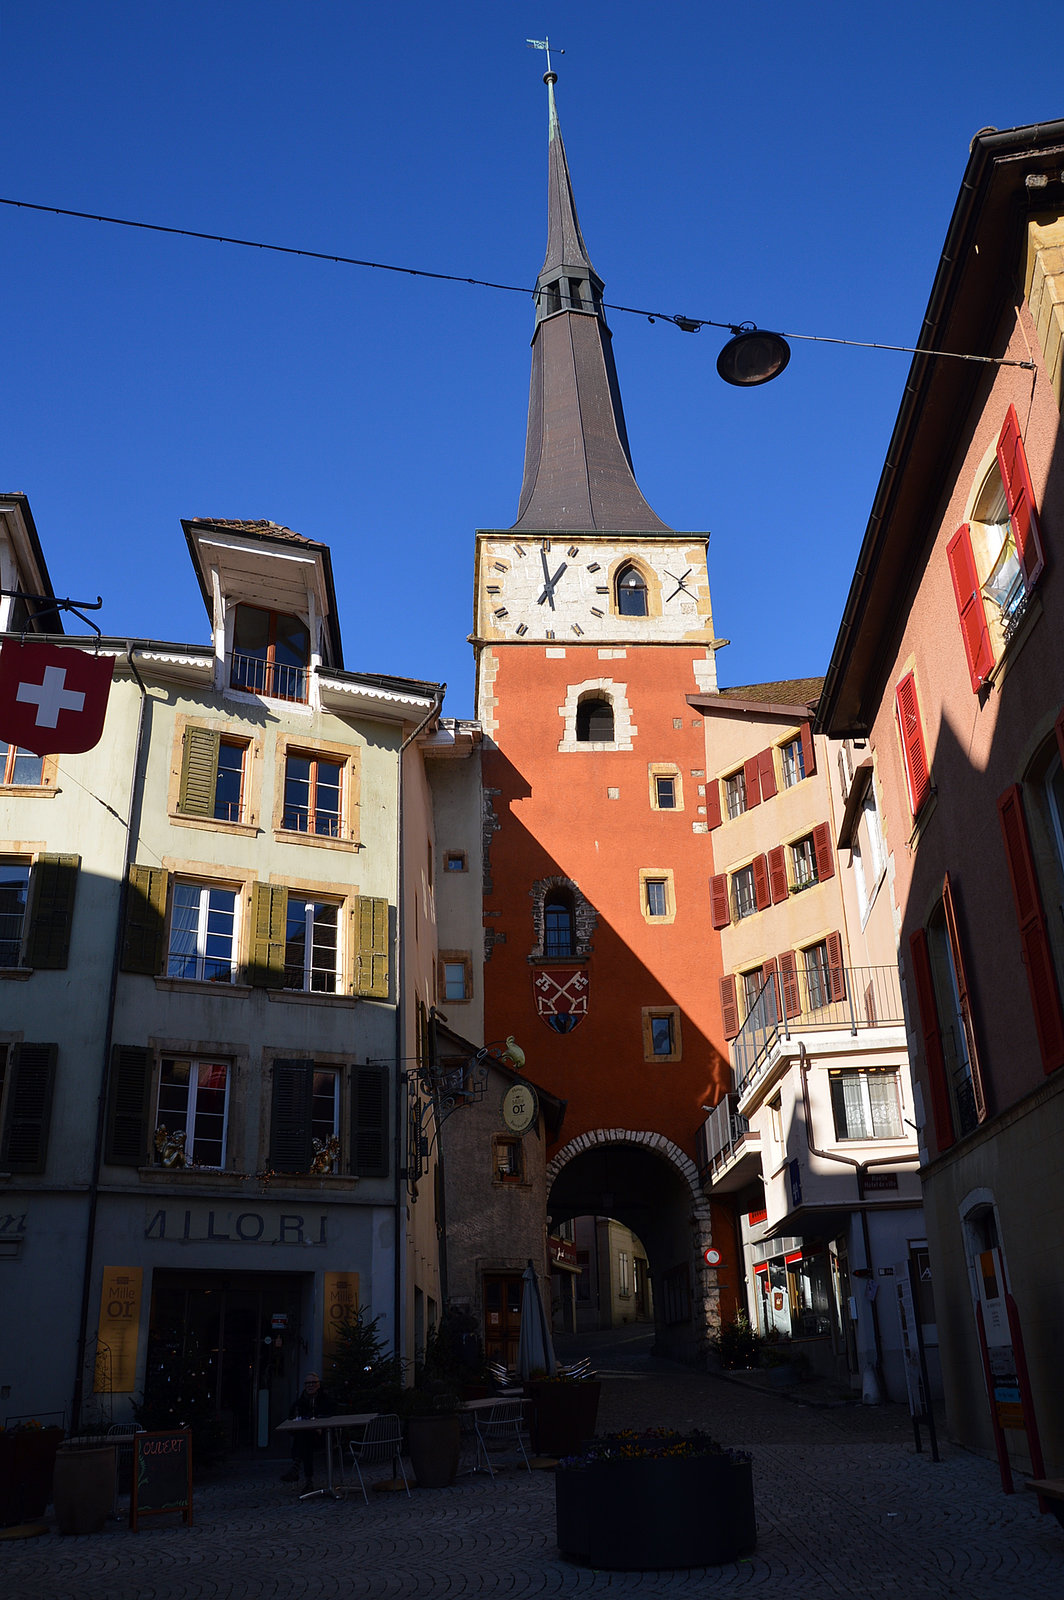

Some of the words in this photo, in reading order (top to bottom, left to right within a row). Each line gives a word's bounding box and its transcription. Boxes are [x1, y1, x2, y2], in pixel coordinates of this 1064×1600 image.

[512, 1103, 526, 1115] or
[108, 1287, 136, 1299] Mille
[330, 1291, 354, 1302] Mille
[107, 1300, 136, 1318] or
[330, 1304, 354, 1320] or
[144, 1440, 184, 1455] OUVERT
